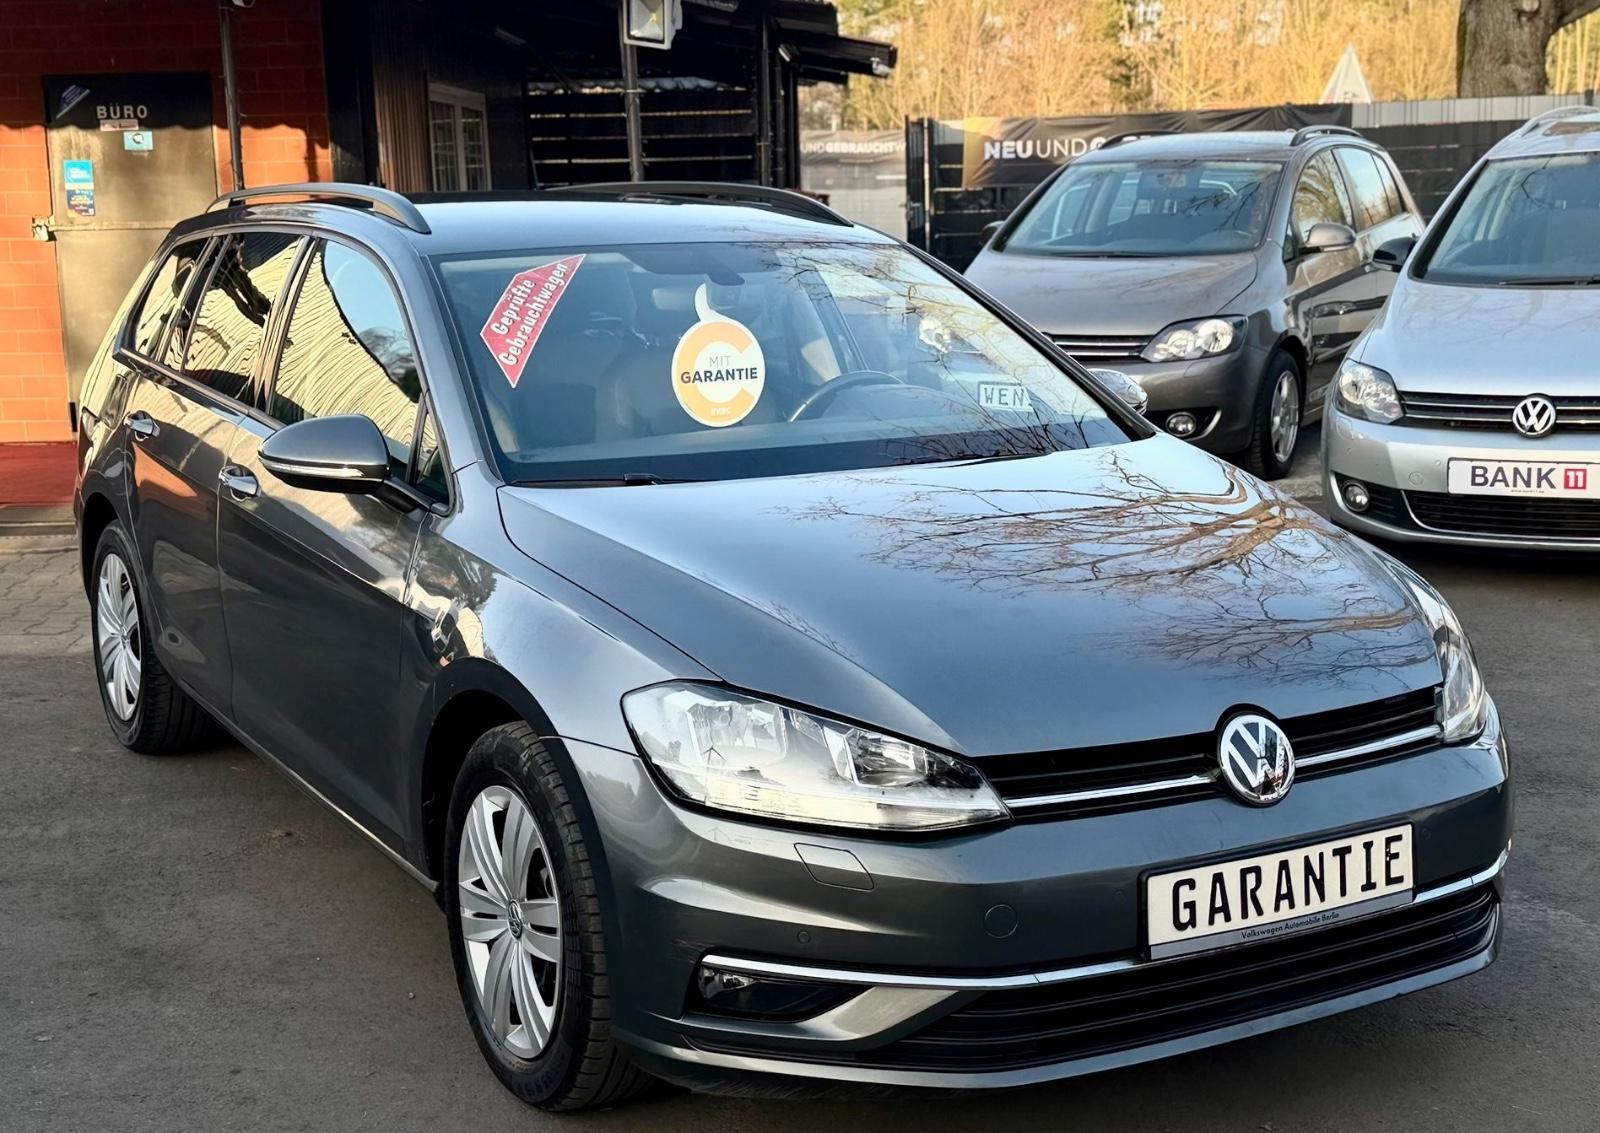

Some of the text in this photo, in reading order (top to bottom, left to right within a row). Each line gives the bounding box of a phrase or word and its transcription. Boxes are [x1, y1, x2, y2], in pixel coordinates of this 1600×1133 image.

[96, 102, 148, 119] BÜRO
[490, 279, 536, 335] Geprüfte
[498, 263, 568, 366] Gebrauchtwagen
[709, 355, 731, 367] MIT
[680, 367, 759, 384] GARANTIE
[1470, 465, 1585, 489] BANK 11
[1172, 834, 1405, 931] GARANTIE
[1241, 911, 1340, 939] Volkswagen Automobile Berlin
